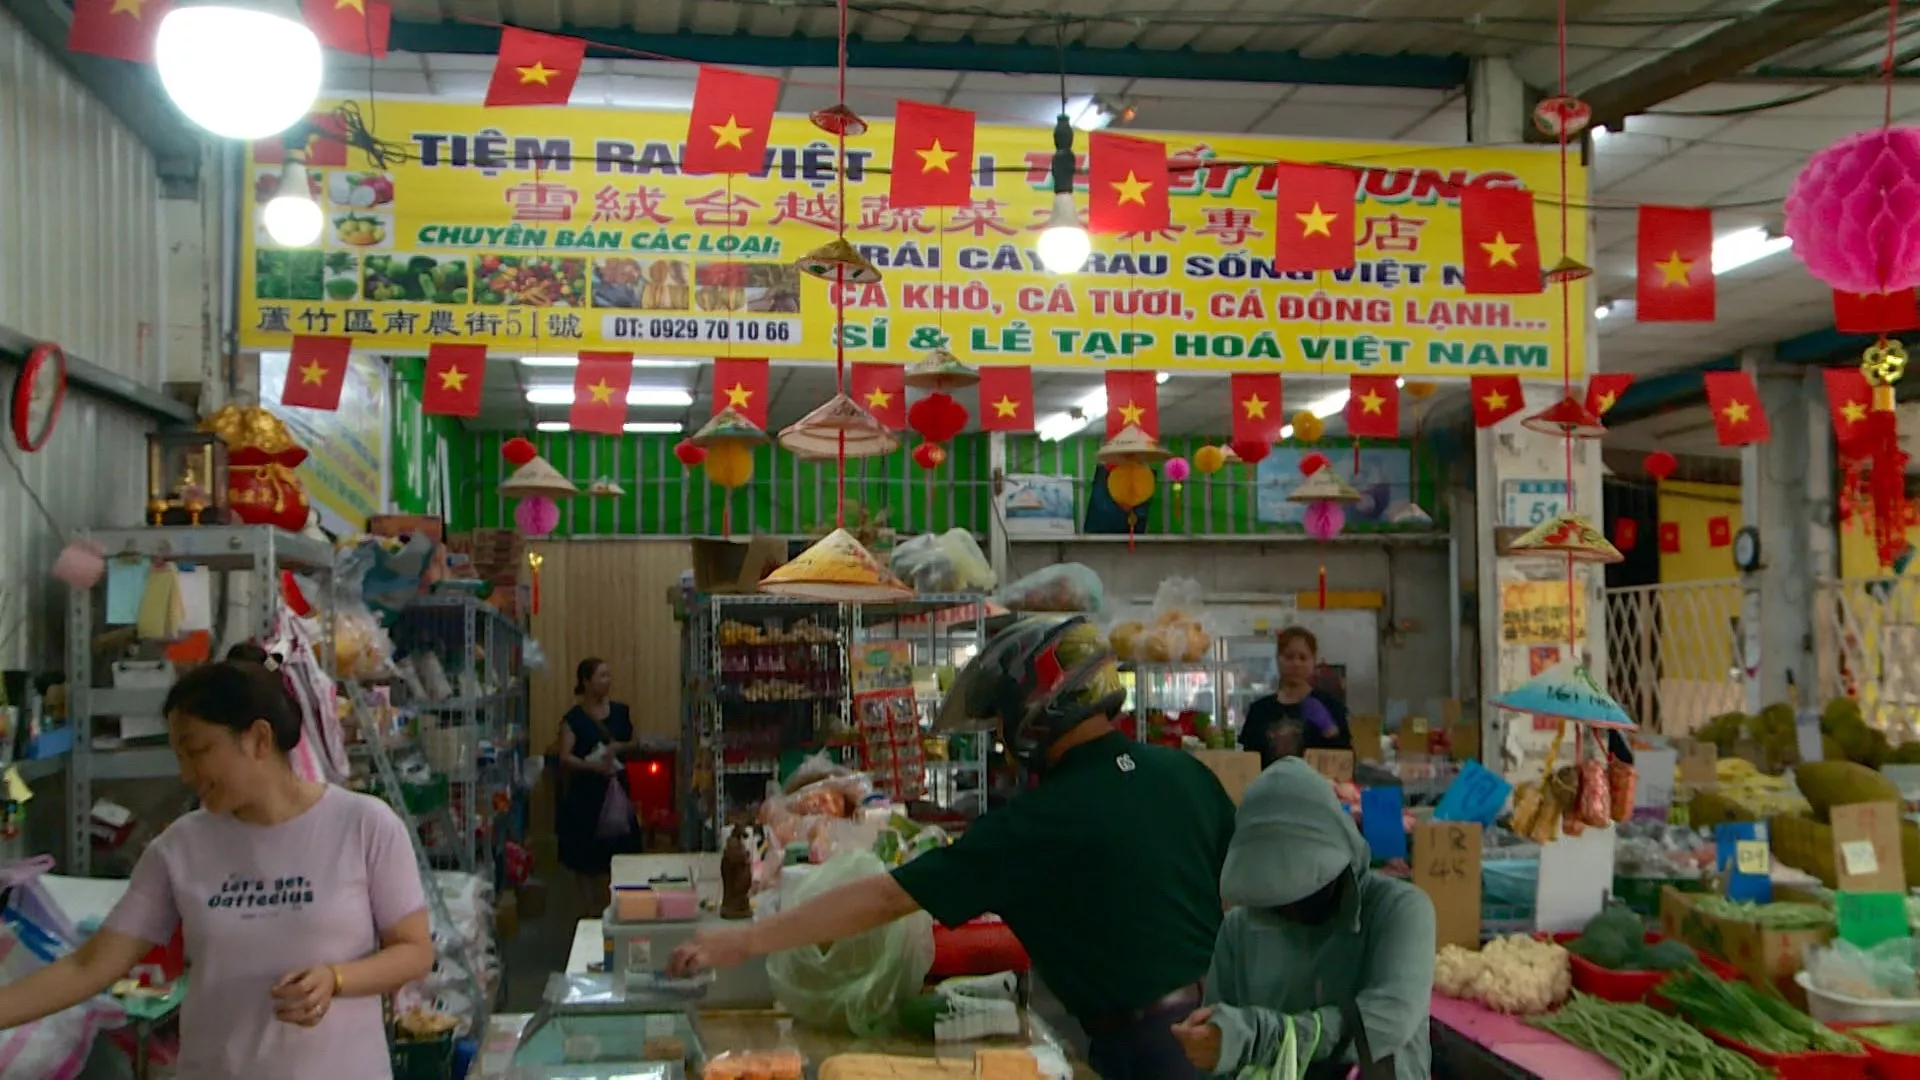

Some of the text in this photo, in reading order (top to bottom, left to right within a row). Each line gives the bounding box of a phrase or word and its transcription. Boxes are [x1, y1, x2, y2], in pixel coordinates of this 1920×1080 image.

[412, 129, 571, 176] TIỆM
[418, 223, 546, 247] CHUYÊN
[554, 226, 622, 249] BÁN
[631, 228, 691, 250] CÁC
[1332, 259, 1426, 288] VIỆT
[256, 305, 583, 340] 蘆竹區南農街51號
[1018, 282, 1075, 313] CÁ
[1210, 289, 1264, 319] CÁ
[1279, 292, 1391, 323] ĐÔNG
[1406, 300, 1547, 330] LẠNH...
[650, 319, 698, 339] 0929
[706, 320, 728, 340] 70
[736, 321, 759, 340] 10
[766, 321, 789, 341] 66
[909, 326, 949, 349] &
[1052, 331, 1154, 360] TẠP
[1175, 331, 1281, 359] HOÁ
[1301, 335, 1410, 366] VIỆT
[1429, 342, 1548, 367] NAM
